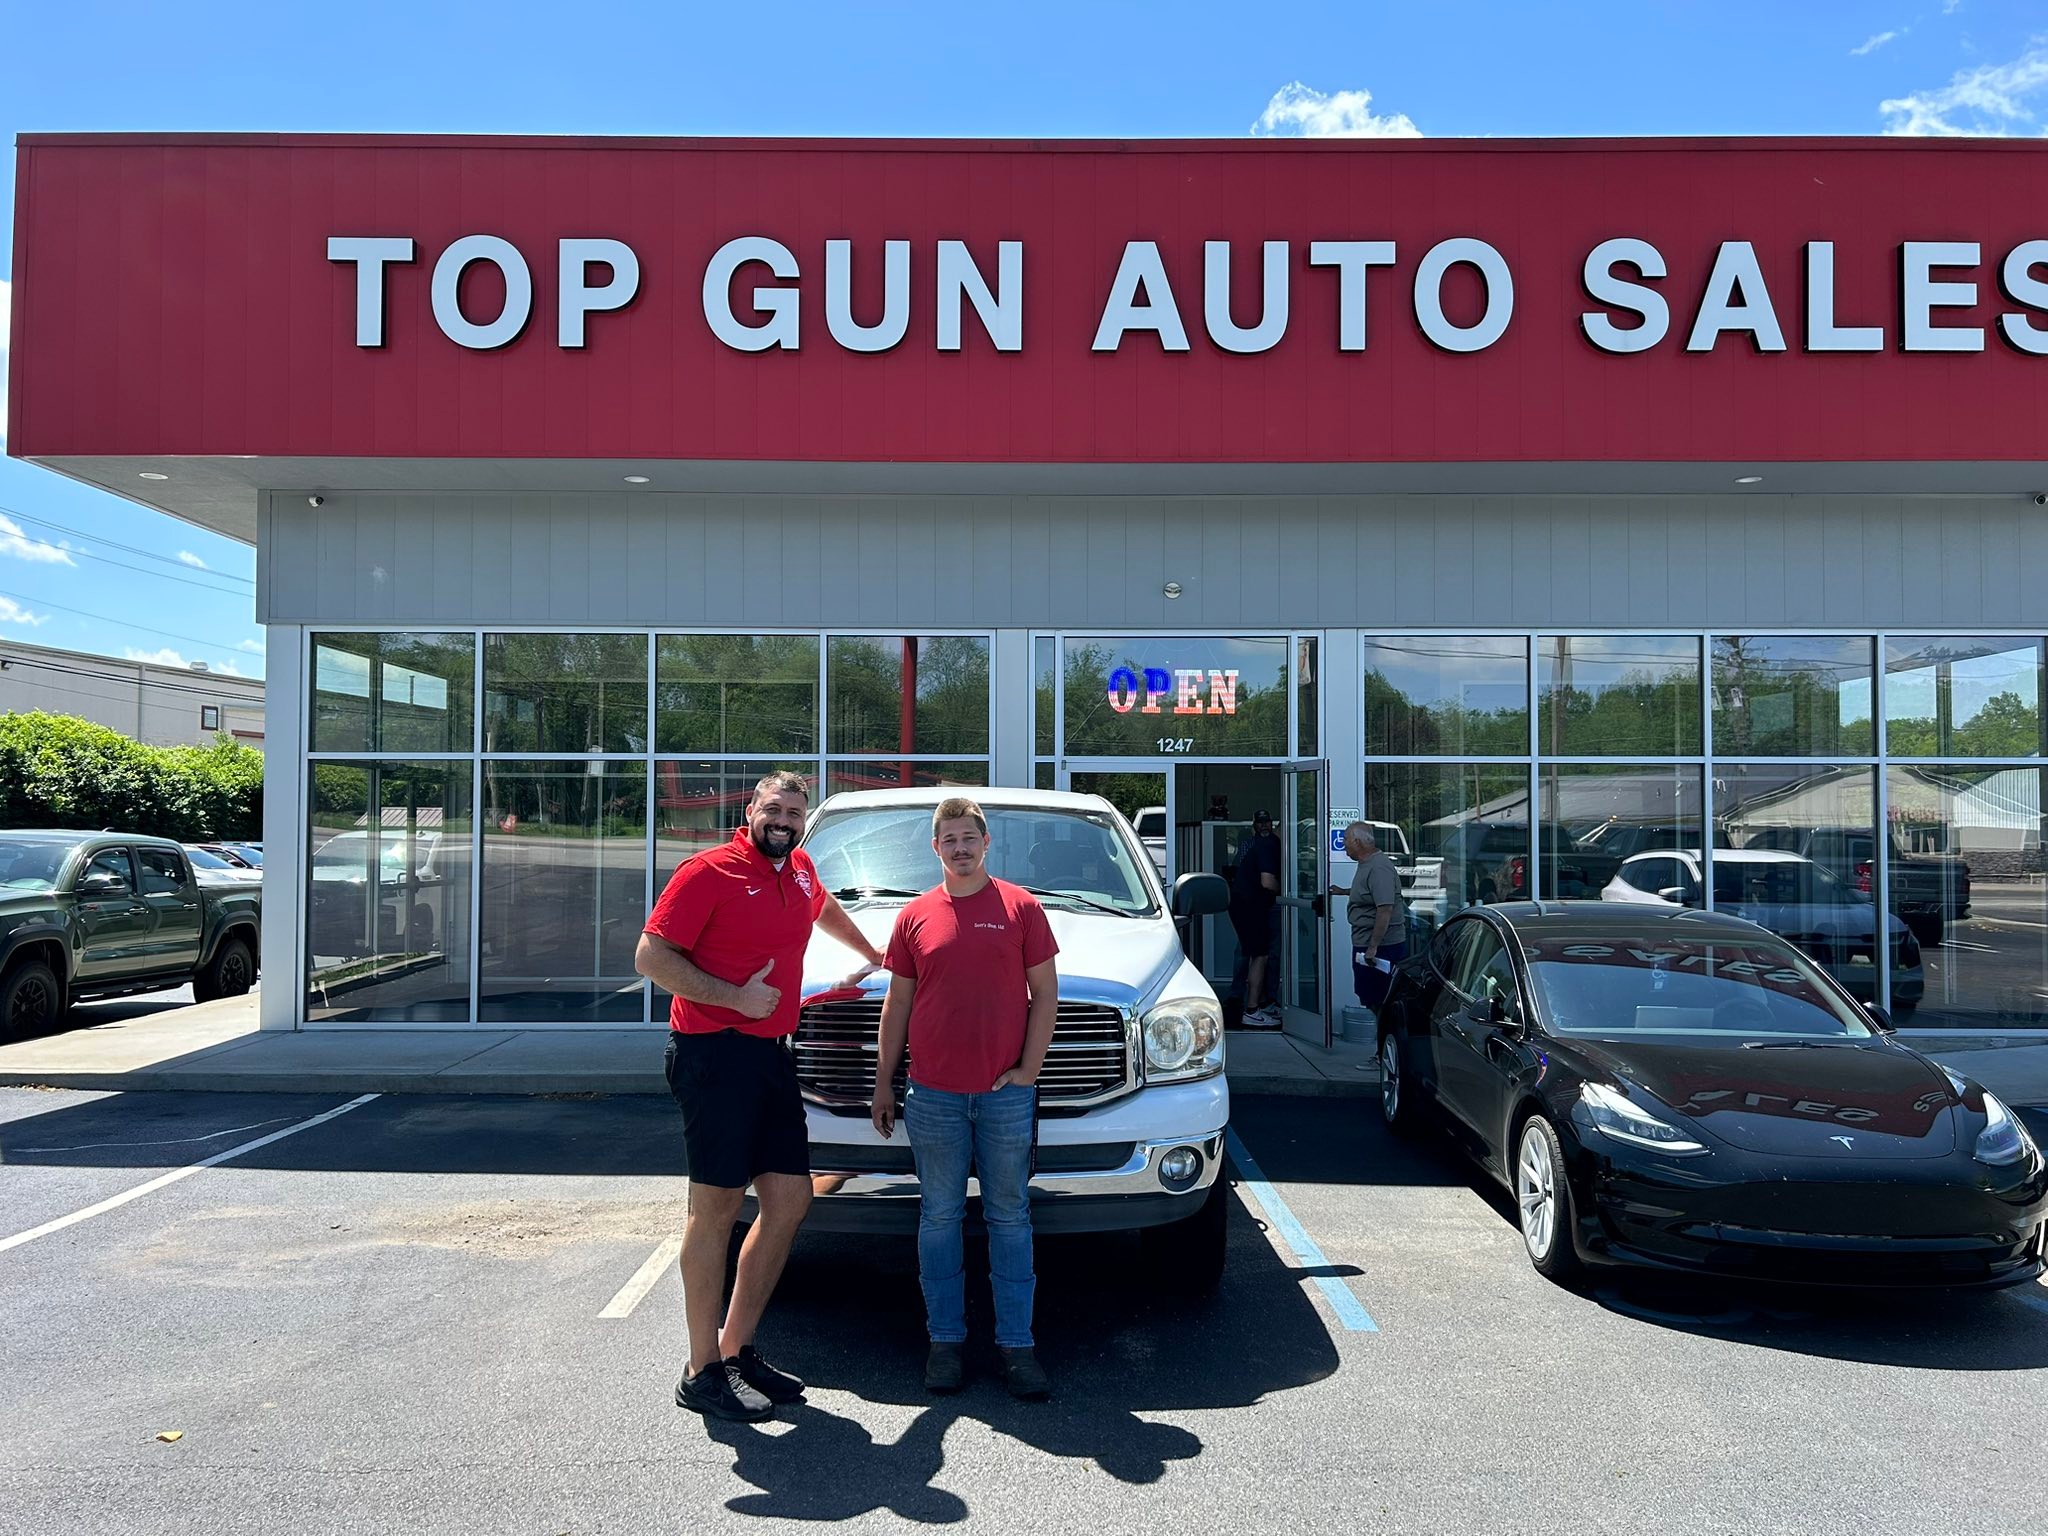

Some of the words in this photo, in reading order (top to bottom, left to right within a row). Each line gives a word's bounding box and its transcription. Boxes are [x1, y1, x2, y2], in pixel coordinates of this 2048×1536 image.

[327, 234, 641, 349] TOP
[702, 236, 1023, 351] GUN
[1090, 237, 1515, 352] AUTO
[1107, 666, 1239, 714] OPEN
[1156, 738, 1194, 753] 1247
[1329, 810, 1359, 819] ESERVED
